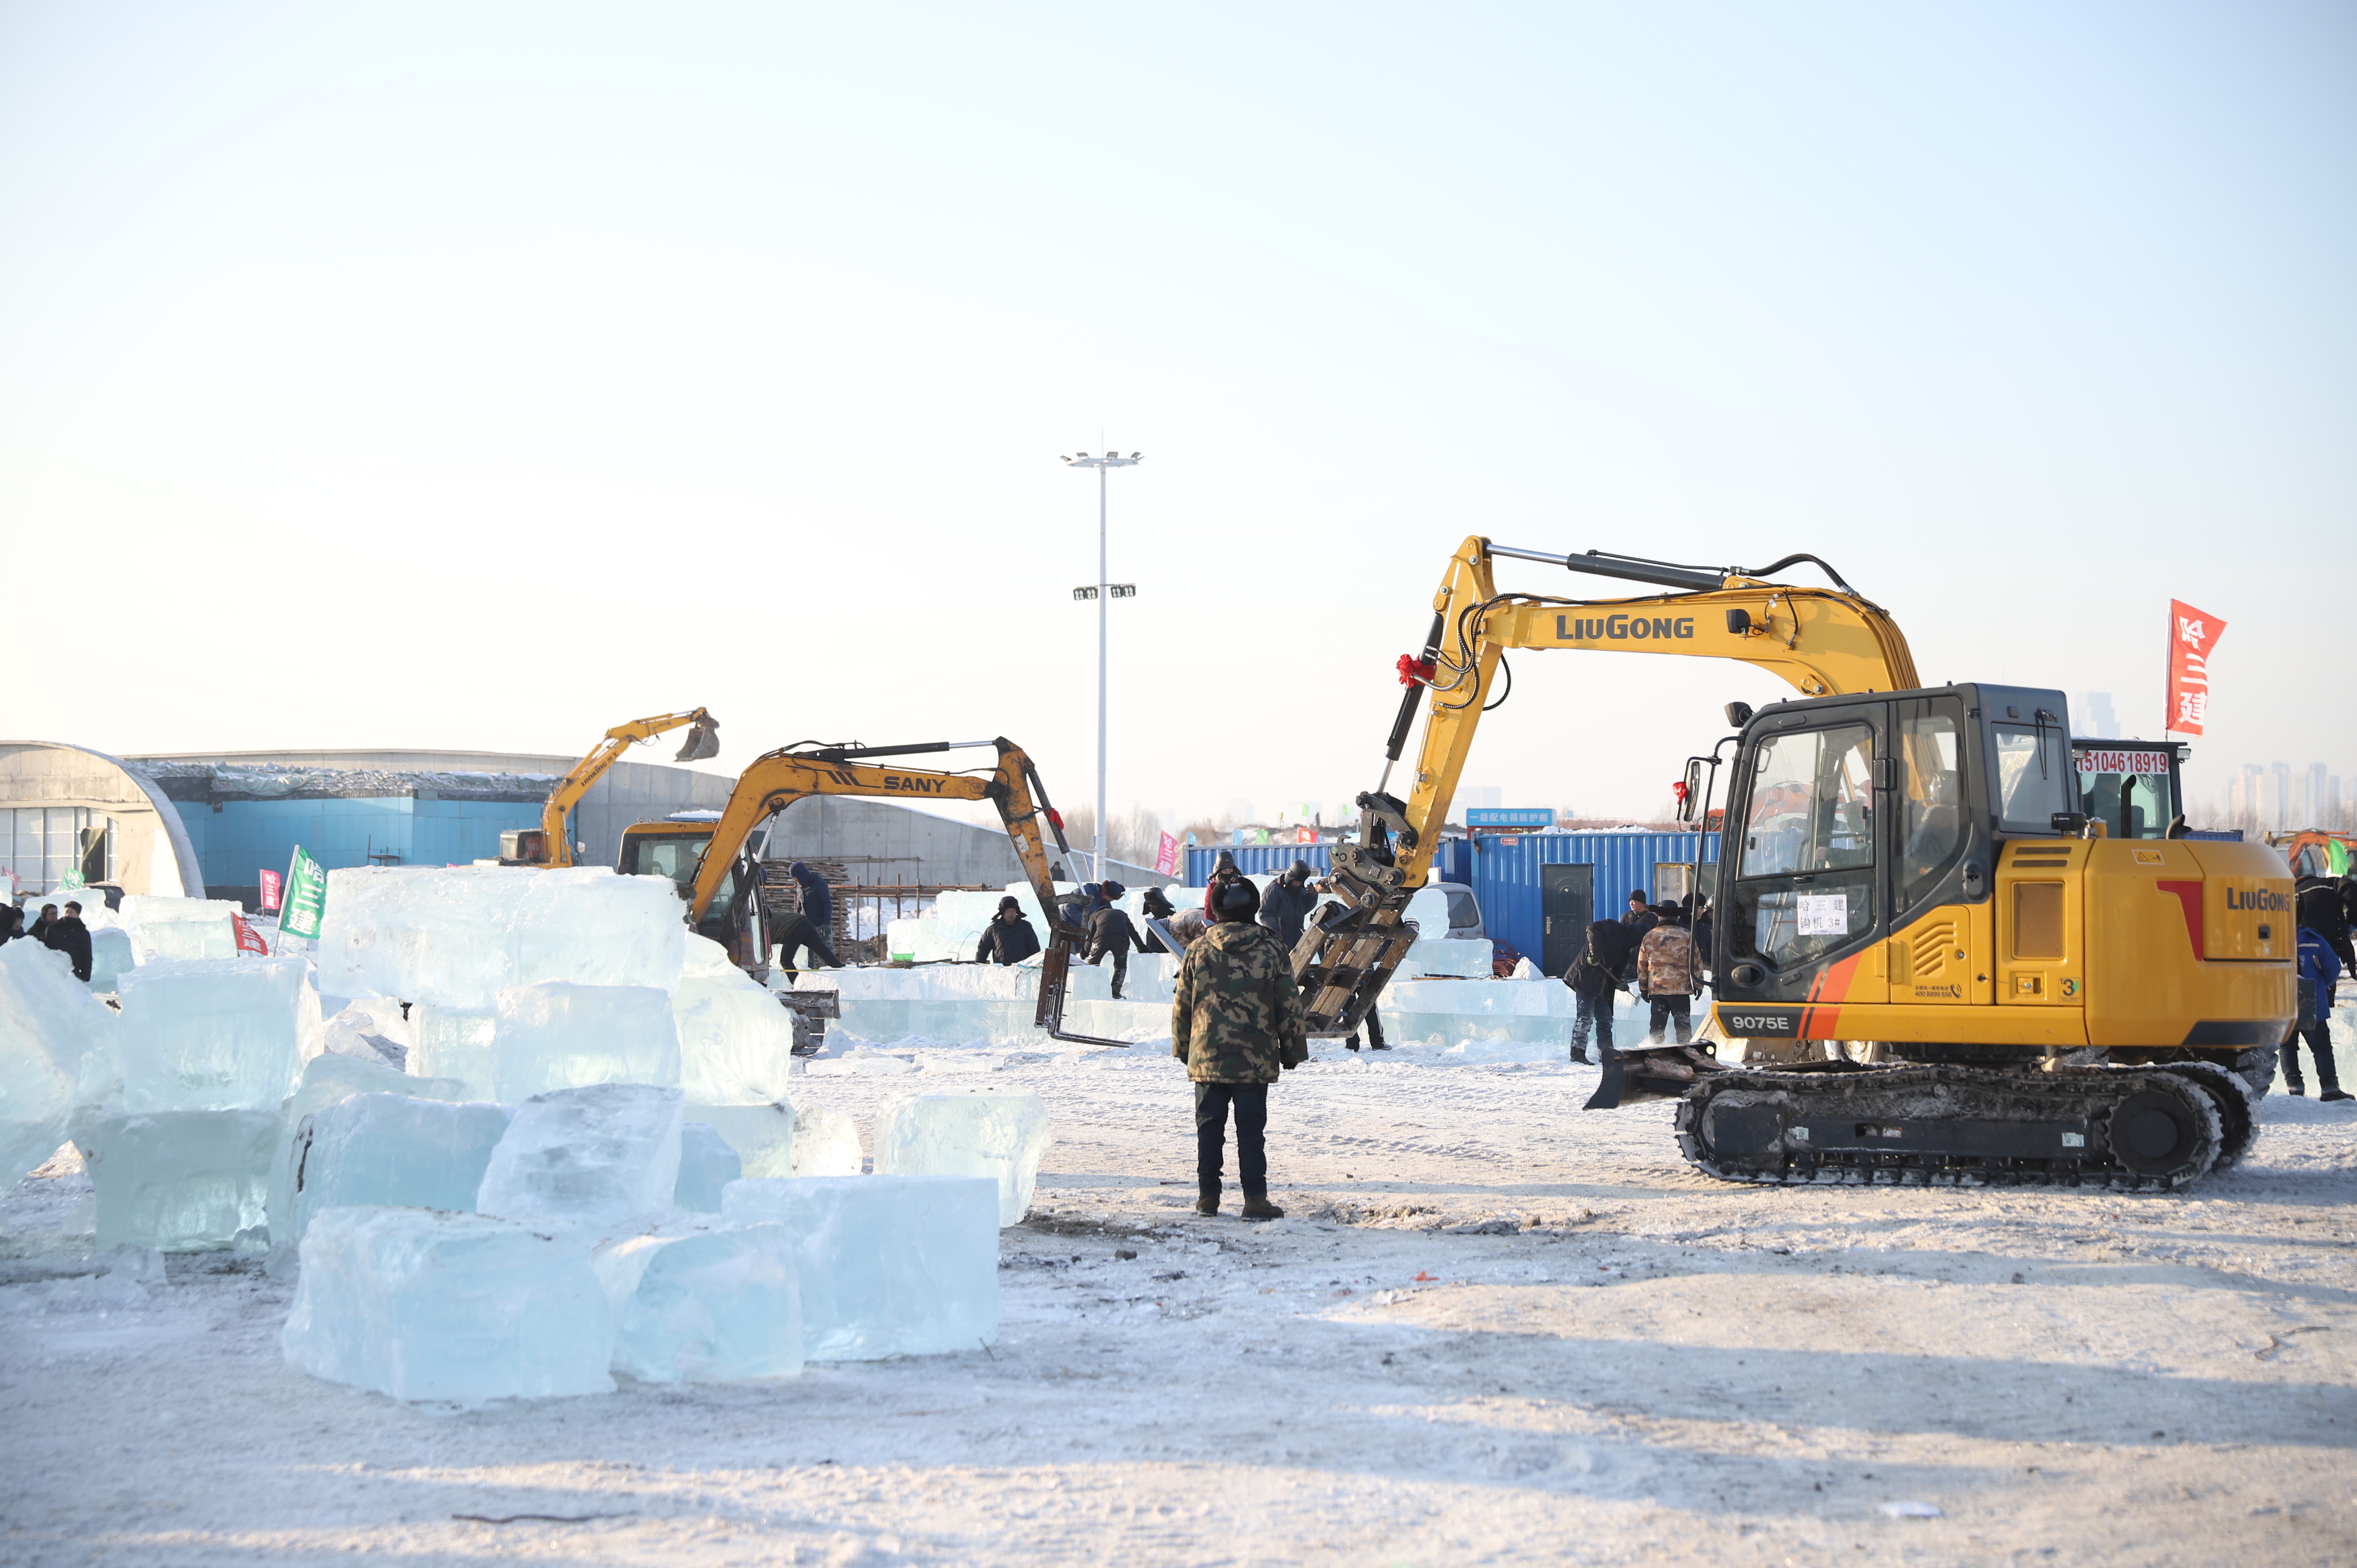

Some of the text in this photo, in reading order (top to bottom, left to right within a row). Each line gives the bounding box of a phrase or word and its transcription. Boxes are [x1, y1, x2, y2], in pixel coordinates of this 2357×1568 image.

[2179, 616, 2209, 726] 哈三建
[884, 776, 947, 793] SANY
[1470, 813, 1548, 822] 一级配电箱防护棚
[265, 874, 276, 907] 哈三建
[286, 858, 325, 934] 哈三建
[1733, 1016, 1789, 1030] 9075E
